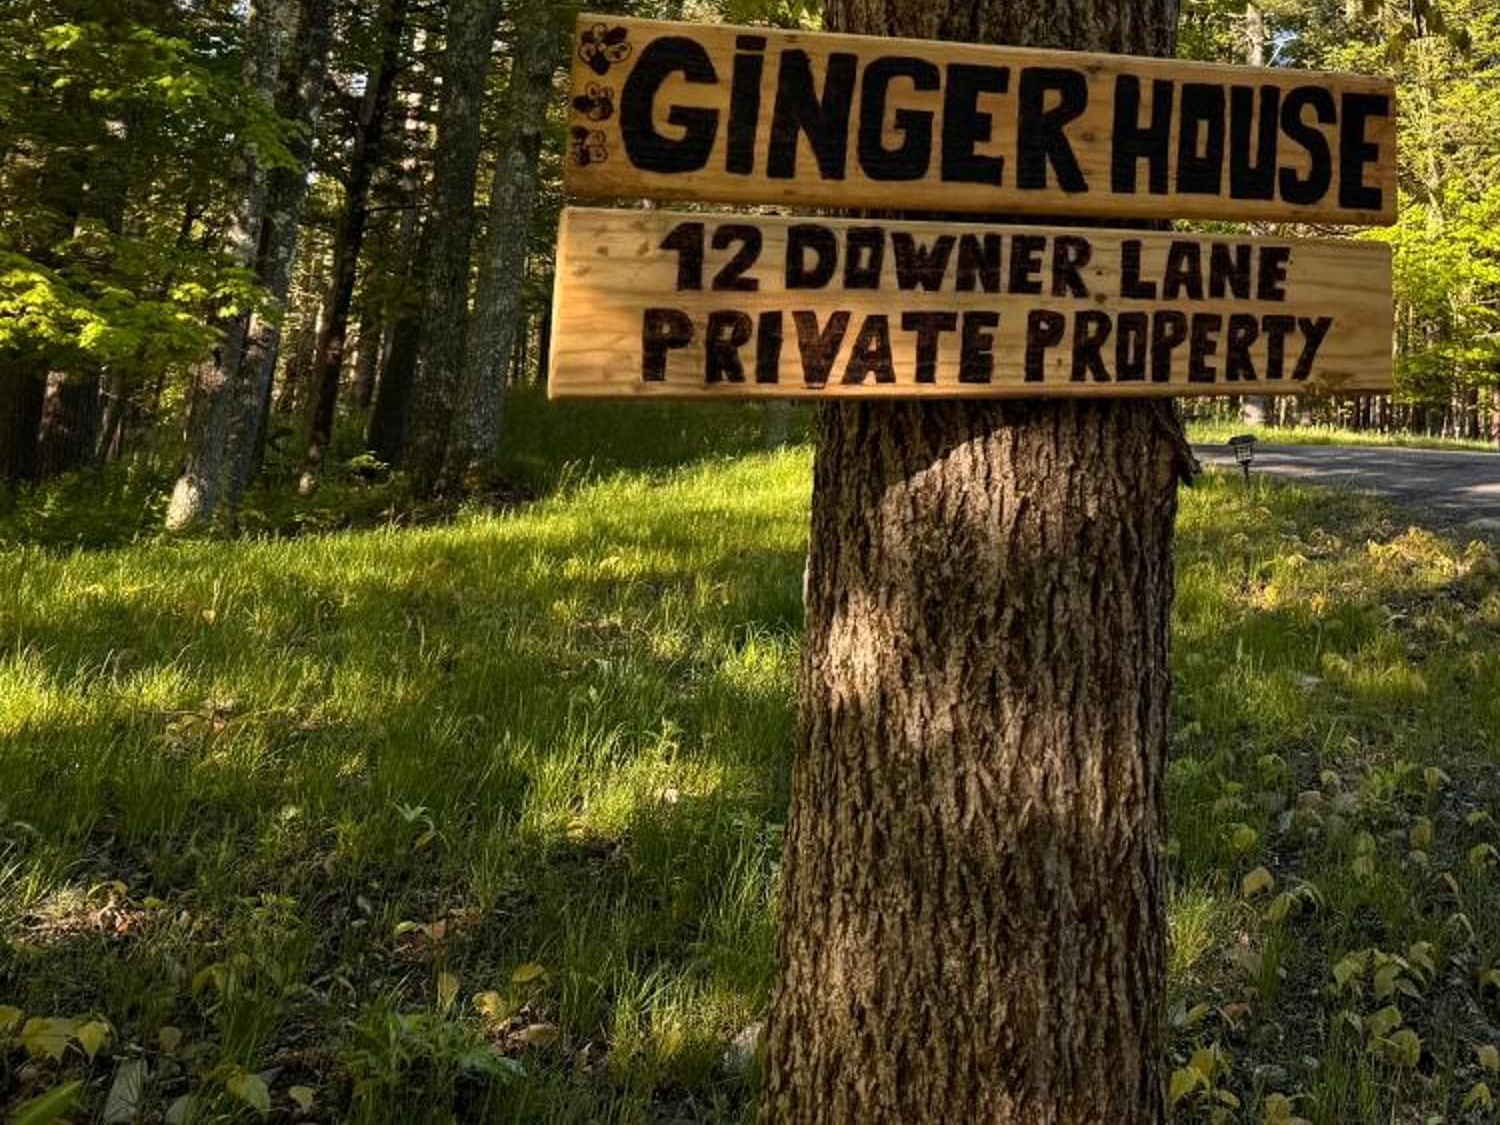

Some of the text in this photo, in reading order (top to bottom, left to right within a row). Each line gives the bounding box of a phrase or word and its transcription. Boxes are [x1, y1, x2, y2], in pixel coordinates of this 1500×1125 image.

[1111, 74, 1391, 210] HOUSE
[659, 222, 1292, 301] 12 DOWNER LANE
[642, 307, 1334, 389] PRIVATE PROPERTY
